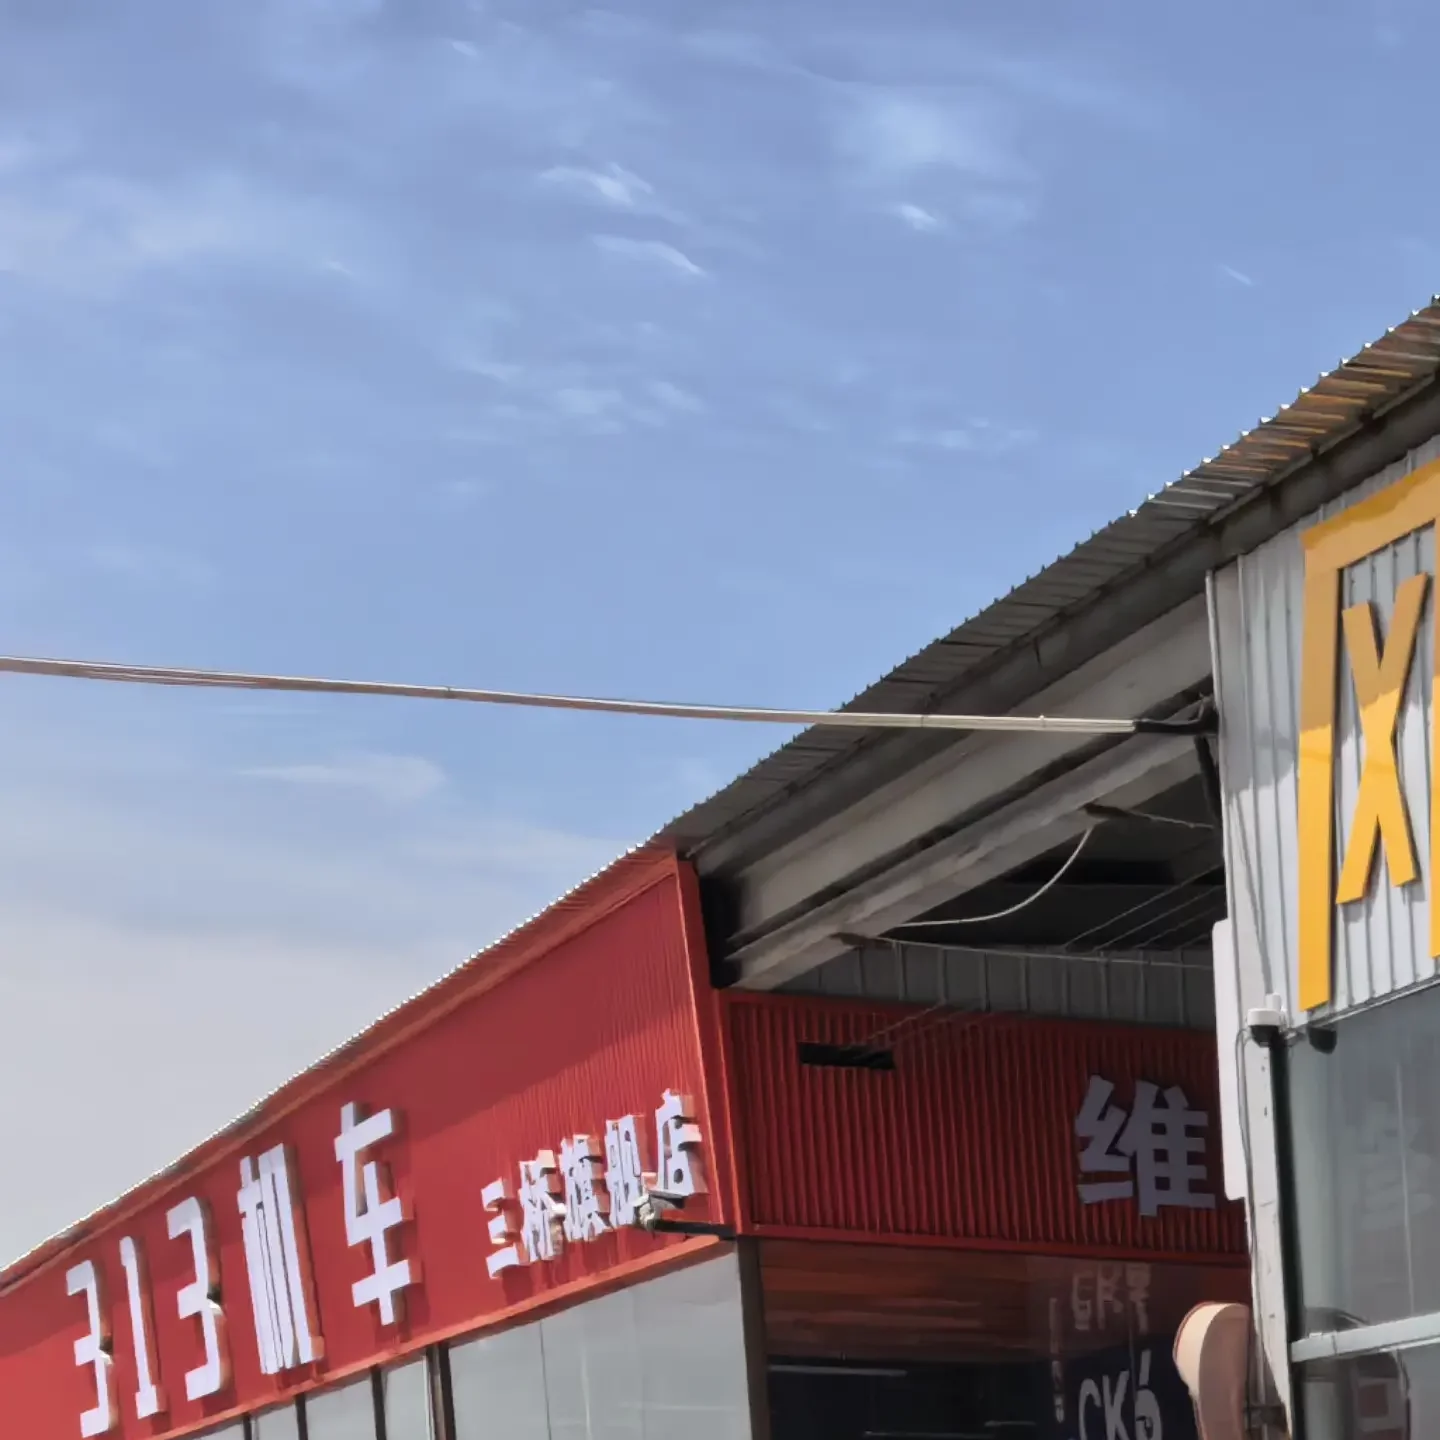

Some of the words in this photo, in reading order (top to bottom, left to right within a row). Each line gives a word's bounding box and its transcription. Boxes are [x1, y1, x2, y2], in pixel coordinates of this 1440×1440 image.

[481, 1088, 702, 1280] 三桥旗舰店
[1074, 1074, 1217, 1217] 维
[66, 1101, 418, 1438] 313机车
